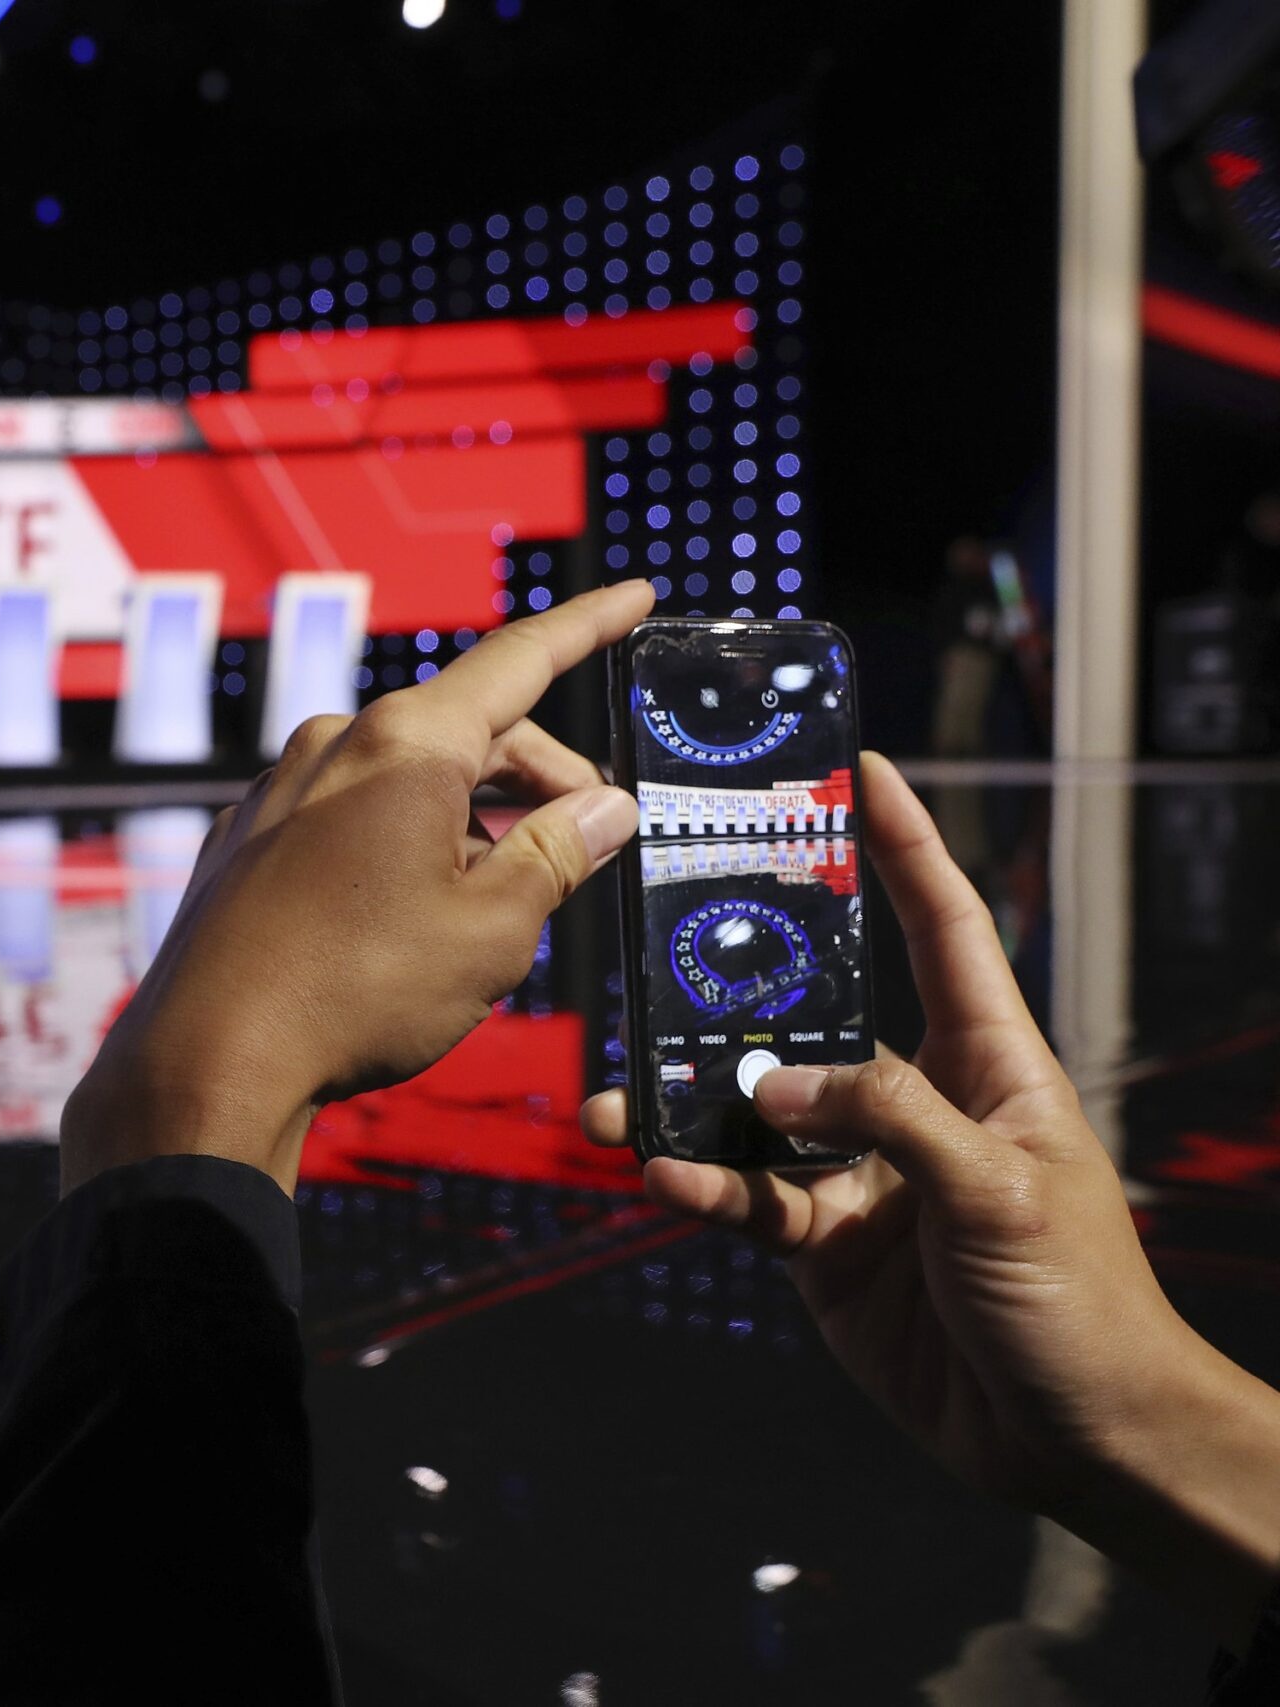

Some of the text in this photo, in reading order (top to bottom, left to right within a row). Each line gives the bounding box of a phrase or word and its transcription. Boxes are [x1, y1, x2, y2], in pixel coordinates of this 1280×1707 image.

[655, 1035, 685, 1046] SLO-MO
[698, 1034, 727, 1045] VIDEO
[743, 1033, 774, 1044] PHOTO
[788, 1031, 825, 1043] SQUARE
